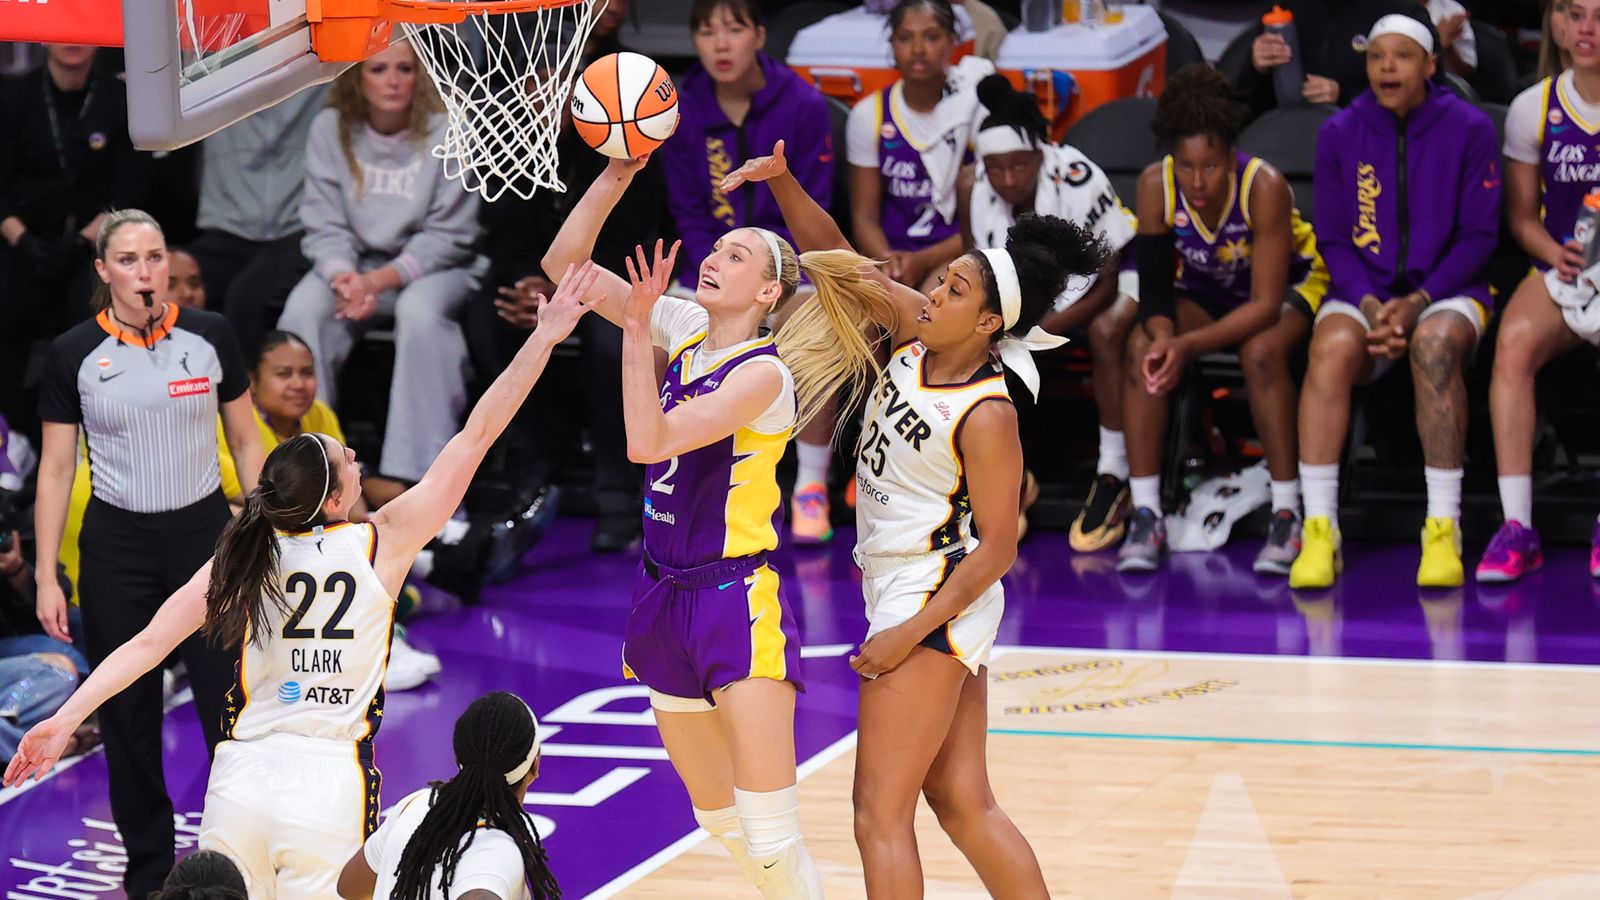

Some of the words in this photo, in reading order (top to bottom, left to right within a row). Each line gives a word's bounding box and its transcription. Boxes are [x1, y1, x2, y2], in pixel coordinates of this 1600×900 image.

[360, 161, 421, 200] IKE
[907, 203, 936, 237] 2
[168, 381, 210, 395] Emirates
[860, 420, 891, 477] 25
[650, 456, 679, 495] 2
[282, 571, 357, 640] 22
[291, 648, 343, 673] CLARK
[305, 686, 355, 705] AT&T
